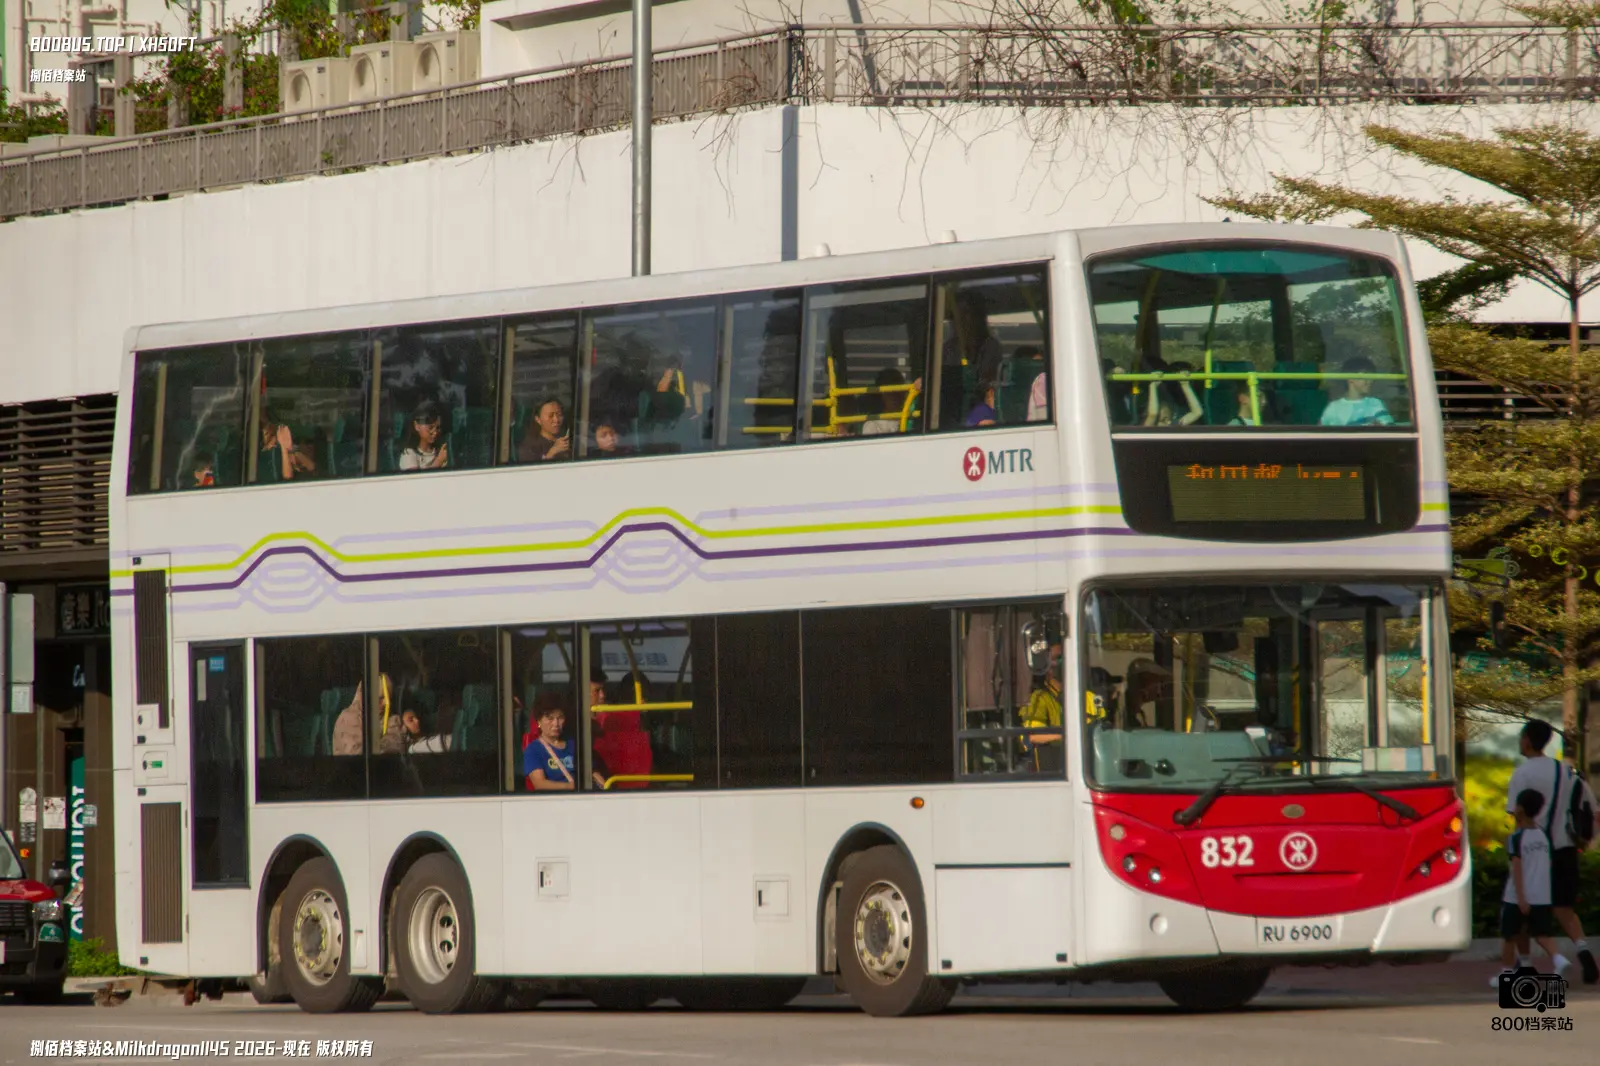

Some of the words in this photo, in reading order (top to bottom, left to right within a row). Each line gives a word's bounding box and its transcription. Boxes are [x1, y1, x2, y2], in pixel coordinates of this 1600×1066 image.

[988, 448, 1034, 475] MTR
[1201, 835, 1255, 868] 832
[1263, 925, 1285, 942] RU
[1289, 924, 1333, 941] 6900
